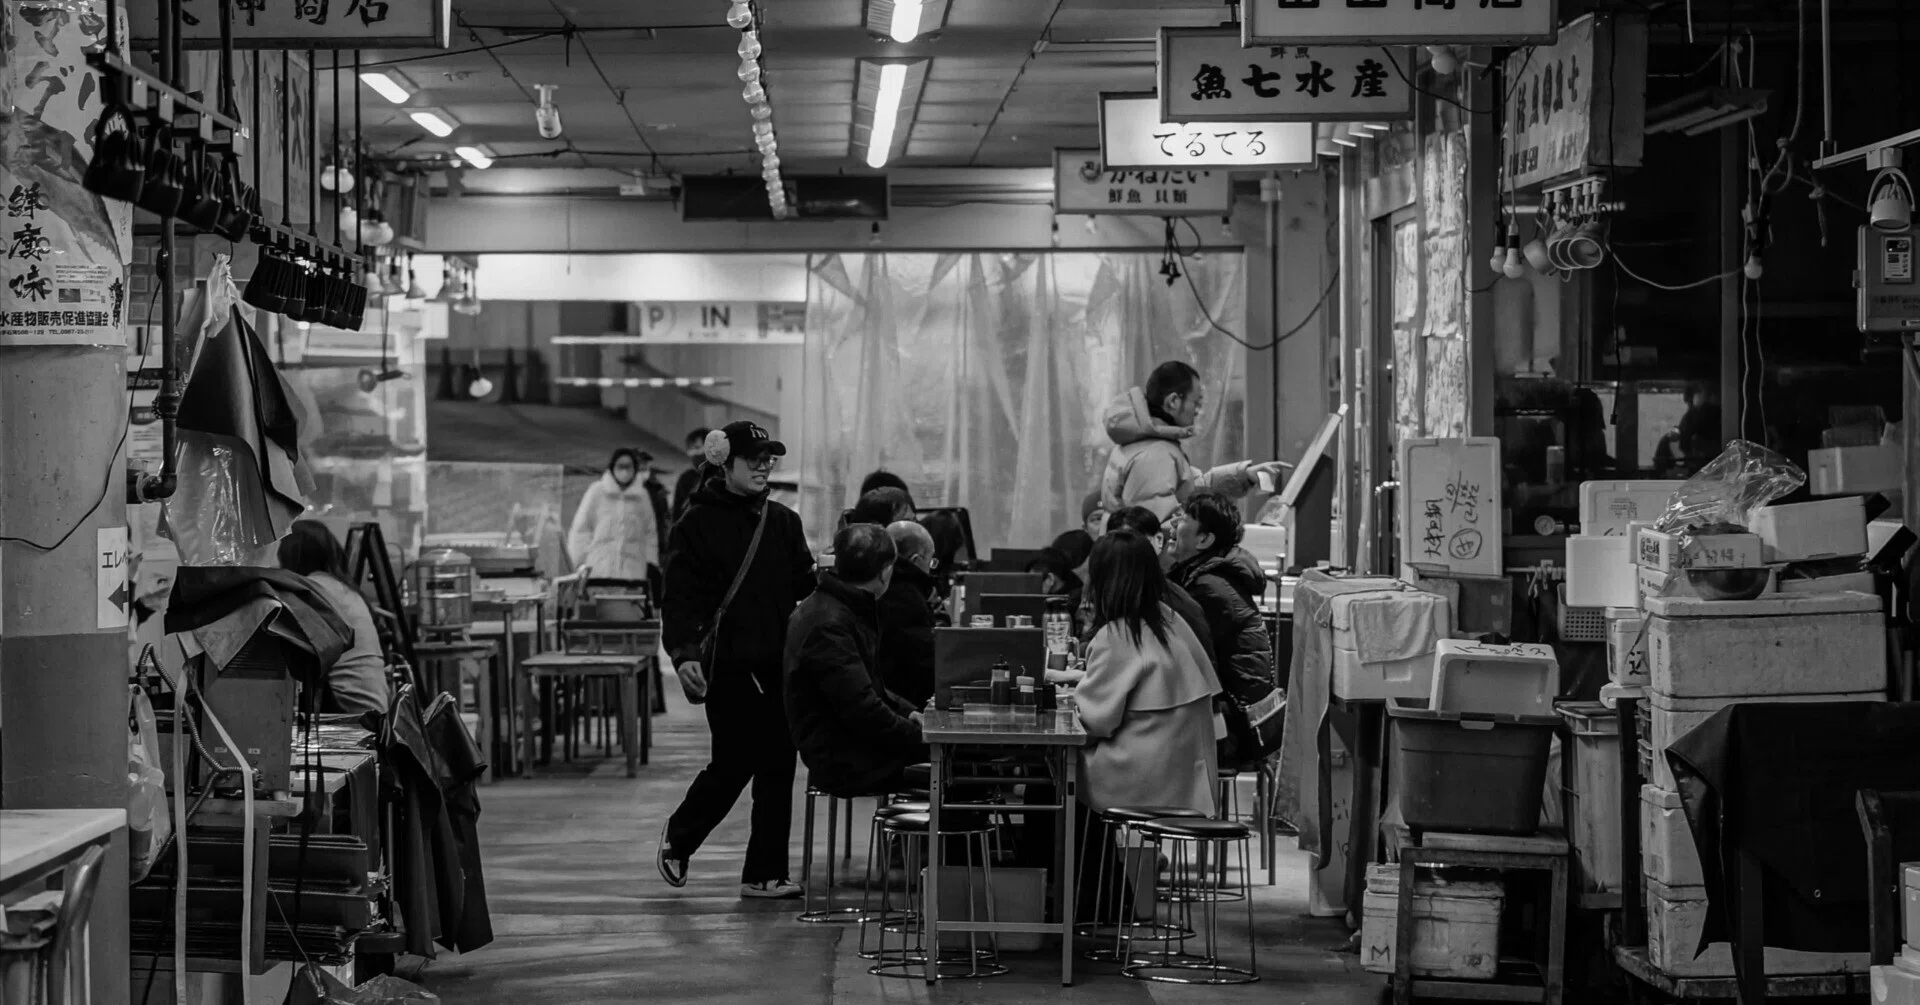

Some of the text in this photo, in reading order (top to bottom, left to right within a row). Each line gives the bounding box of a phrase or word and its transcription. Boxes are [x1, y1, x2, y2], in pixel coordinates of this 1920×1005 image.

[1190, 58, 1389, 101] 魚七水産
[1153, 131, 1266, 157] てるてる
[650, 305, 664, 330] P
[702, 304, 731, 329] IN
[102, 552, 128, 569] エレ
